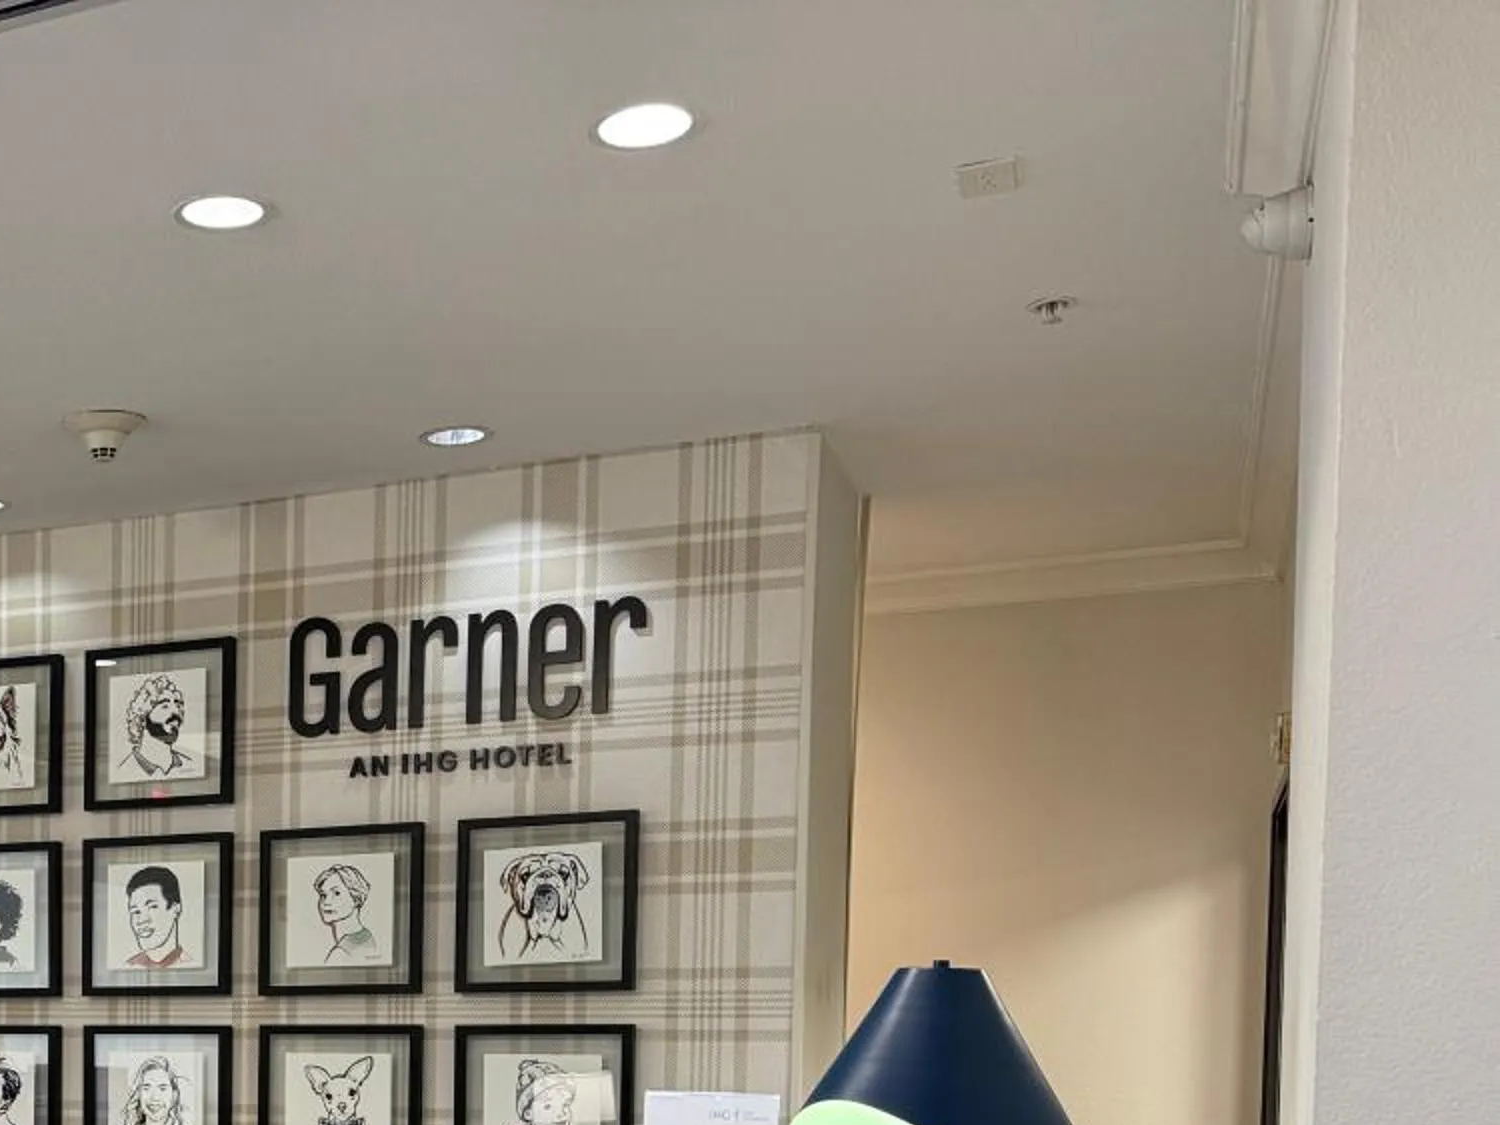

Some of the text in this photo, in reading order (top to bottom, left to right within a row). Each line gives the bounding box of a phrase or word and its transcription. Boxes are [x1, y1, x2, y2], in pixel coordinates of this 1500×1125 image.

[288, 595, 649, 738] Garner
[350, 743, 572, 778] AN IHG HOTEL
